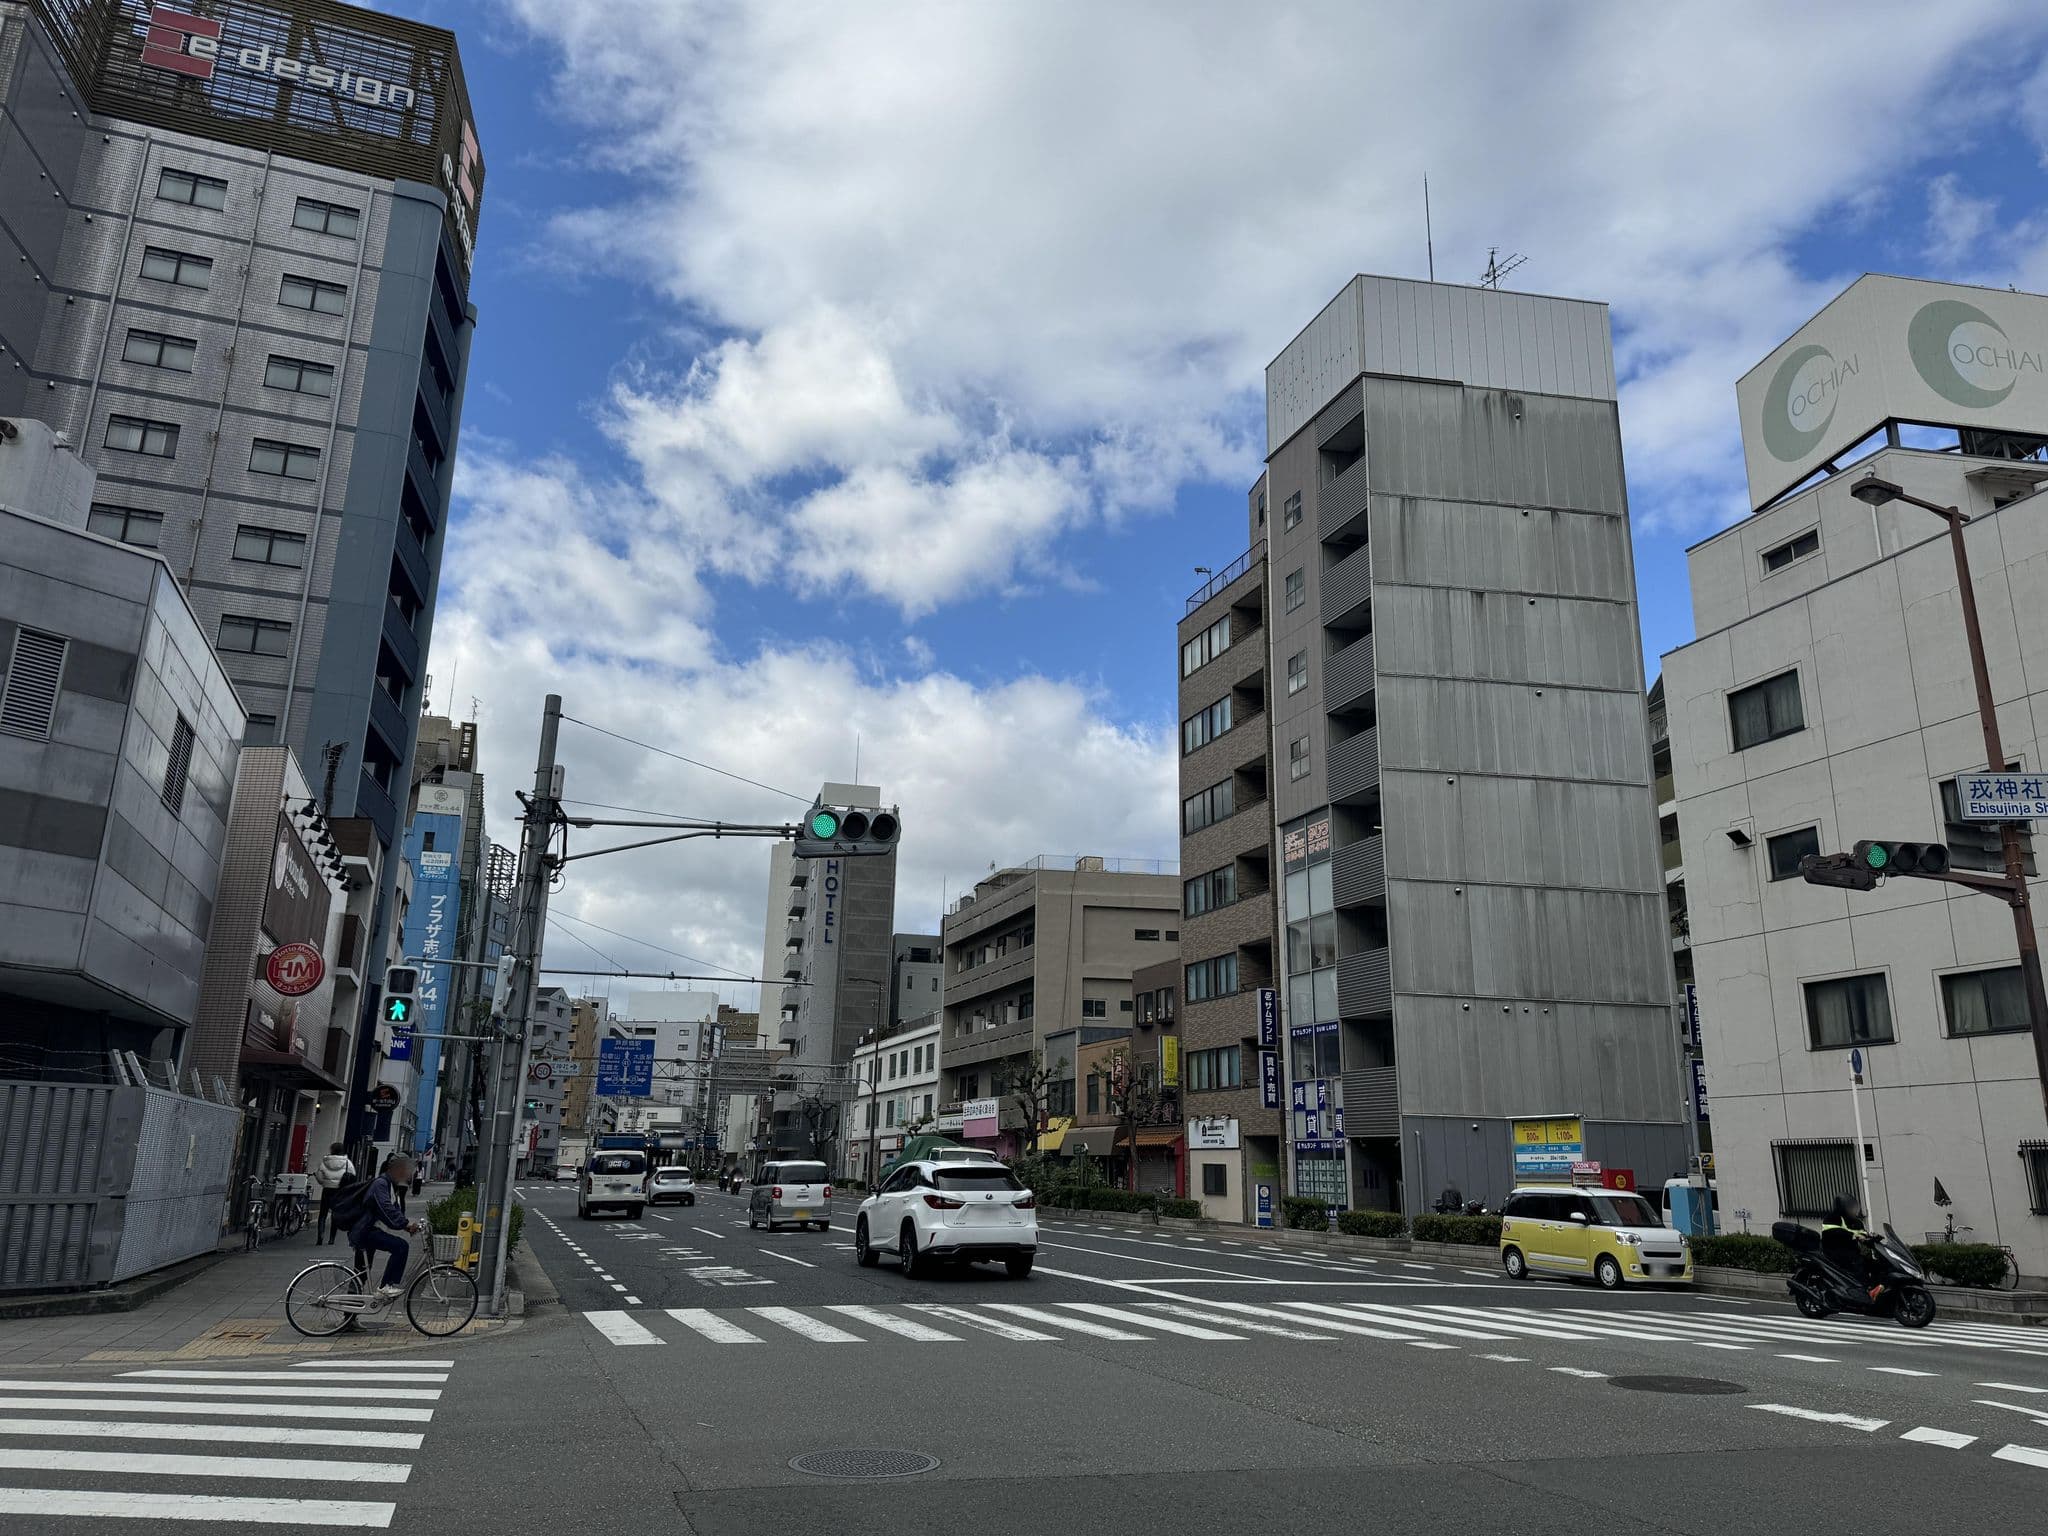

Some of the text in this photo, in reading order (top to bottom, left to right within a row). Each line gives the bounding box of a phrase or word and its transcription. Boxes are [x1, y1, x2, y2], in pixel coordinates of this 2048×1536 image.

[188, 35, 415, 109] e-design
[1953, 343, 2043, 373] OCHIAI
[1791, 353, 1860, 417] OCHIAI
[1968, 778, 2048, 800] 戎神社
[1970, 802, 2031, 815] Ebisujinja
[824, 859, 839, 944] HOTEL
[273, 961, 315, 979] HM
[1265, 1002, 1273, 1042] サムランド
[391, 1040, 406, 1048] ANK
[538, 1066, 549, 1076] 50
[1266, 1057, 1276, 1103] 賃貸・売買
[1294, 1087, 1304, 1105] 賃
[1307, 1115, 1317, 1133] 貸
